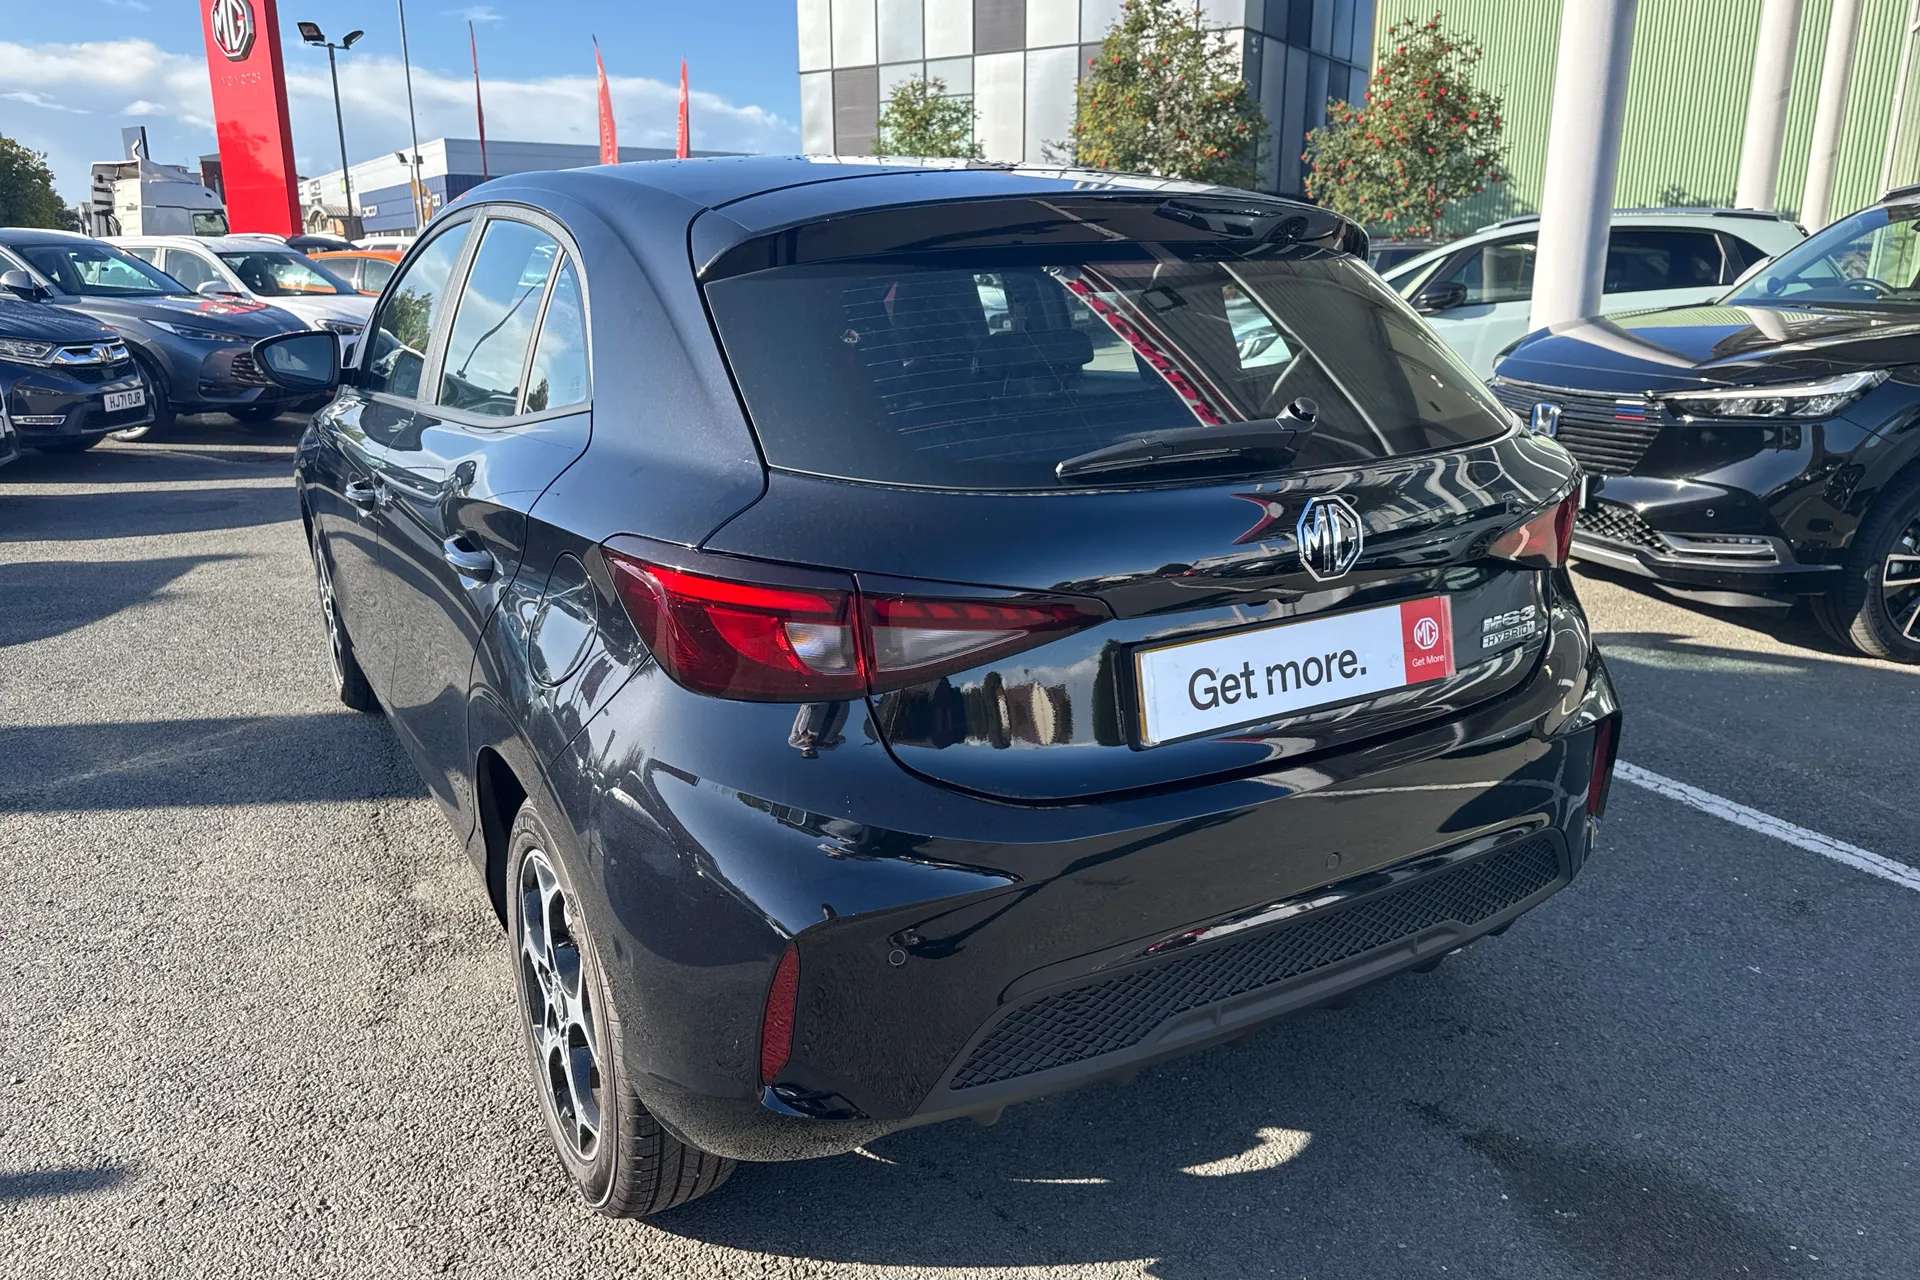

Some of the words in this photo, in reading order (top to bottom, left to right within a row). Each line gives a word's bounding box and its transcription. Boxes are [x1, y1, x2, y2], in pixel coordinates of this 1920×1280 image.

[212, 0, 246, 51] MG
[110, 394, 127, 409] HJ71
[1301, 501, 1359, 575] MG
[1482, 604, 1536, 633] MG3
[1415, 619, 1438, 648] MG
[1411, 658, 1425, 667] Get
[1426, 654, 1446, 665] More
[1188, 661, 1258, 711] Get
[1265, 649, 1367, 696] more.
